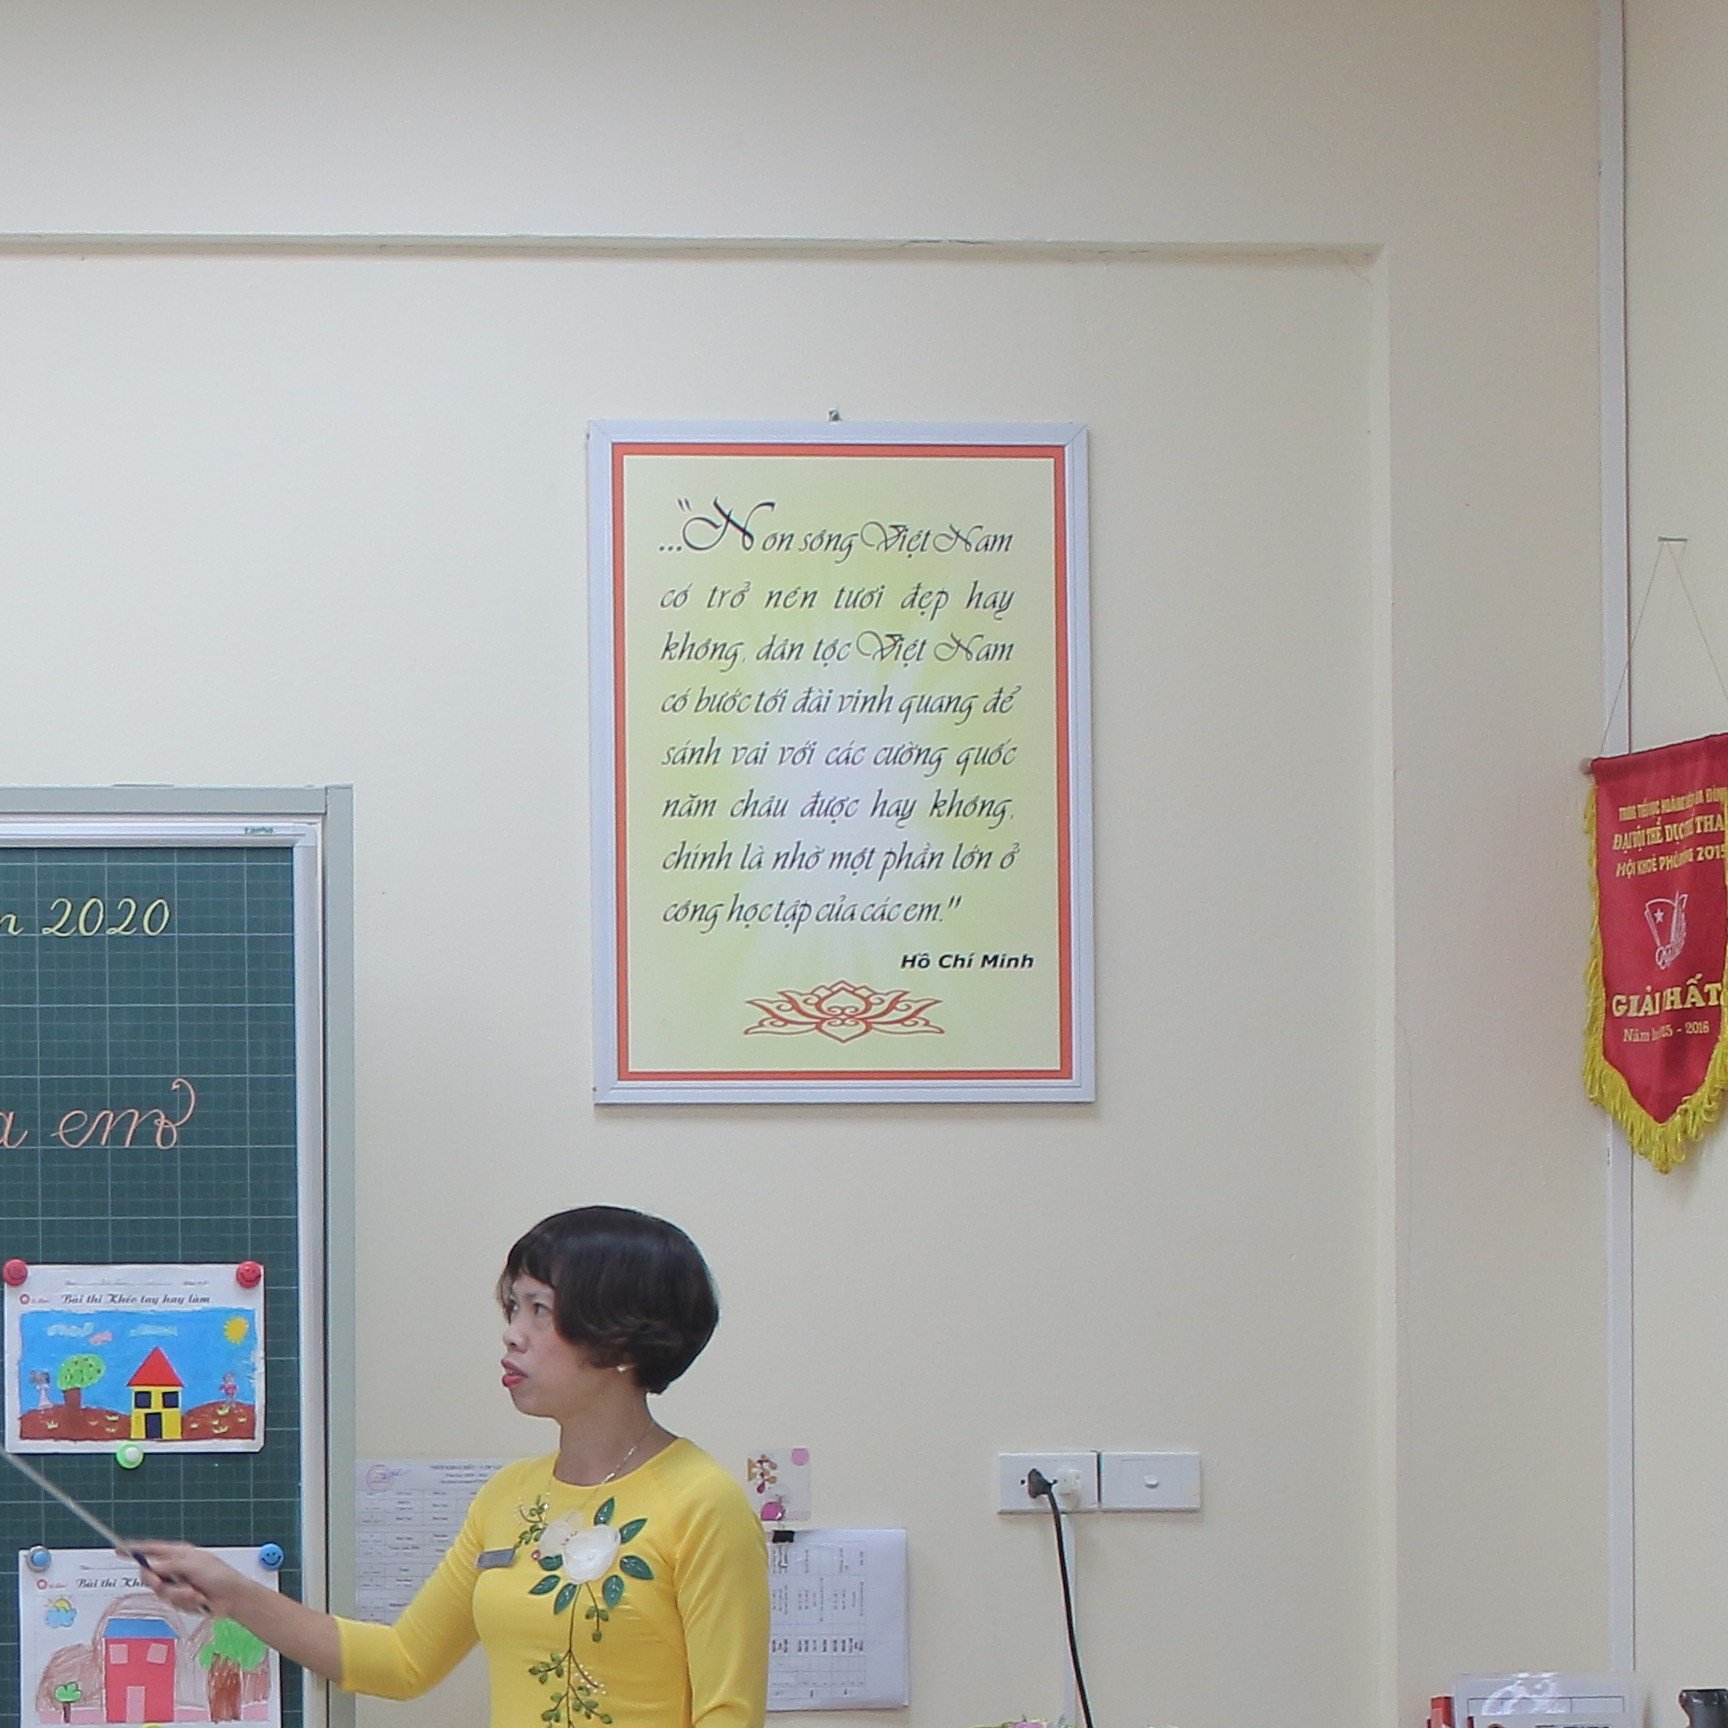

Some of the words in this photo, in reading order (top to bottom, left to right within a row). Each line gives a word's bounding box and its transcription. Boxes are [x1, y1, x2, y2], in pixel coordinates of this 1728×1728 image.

[860, 521, 931, 559] Việt
[933, 523, 1014, 553] Nam
[659, 583, 693, 609] có
[707, 581, 751, 609] trở
[834, 584, 886, 609] tươi
[900, 582, 949, 622] đẹp
[966, 580, 1015, 620] hay
[812, 638, 851, 668] tộc
[856, 630, 928, 668] Việt
[933, 631, 1015, 662] Nam
[660, 686, 691, 714] có
[694, 685, 751, 714] bước
[753, 687, 789, 714] tới
[792, 686, 833, 714] đài
[838, 684, 894, 714] vinh
[898, 692, 980, 726] quang
[983, 685, 1023, 714] để
[660, 735, 721, 767] sánh
[730, 741, 770, 766] vai
[777, 740, 817, 766] với
[824, 740, 867, 766] các
[872, 741, 949, 778] cường
[955, 738, 1018, 776] quốc
[661, 793, 718, 818] năm
[799, 790, 861, 825] được
[869, 788, 918, 829] hay
[661, 840, 732, 871] chính
[739, 843, 764, 870] là
[771, 840, 826, 871] nhờ
[828, 847, 876, 877] một
[879, 840, 947, 882] phần
[952, 843, 994, 870] lớn
[999, 842, 1020, 870] ở
[42, 898, 171, 937] 2020
[726, 892, 775, 930] học
[775, 898, 813, 933] tập
[815, 894, 859, 923] của
[860, 896, 904, 923] các
[938, 952, 972, 970] Chí
[980, 953, 1035, 970] Minh
[1612, 985, 1661, 1018] GIẢI
[1662, 973, 1722, 1011] HẤT
